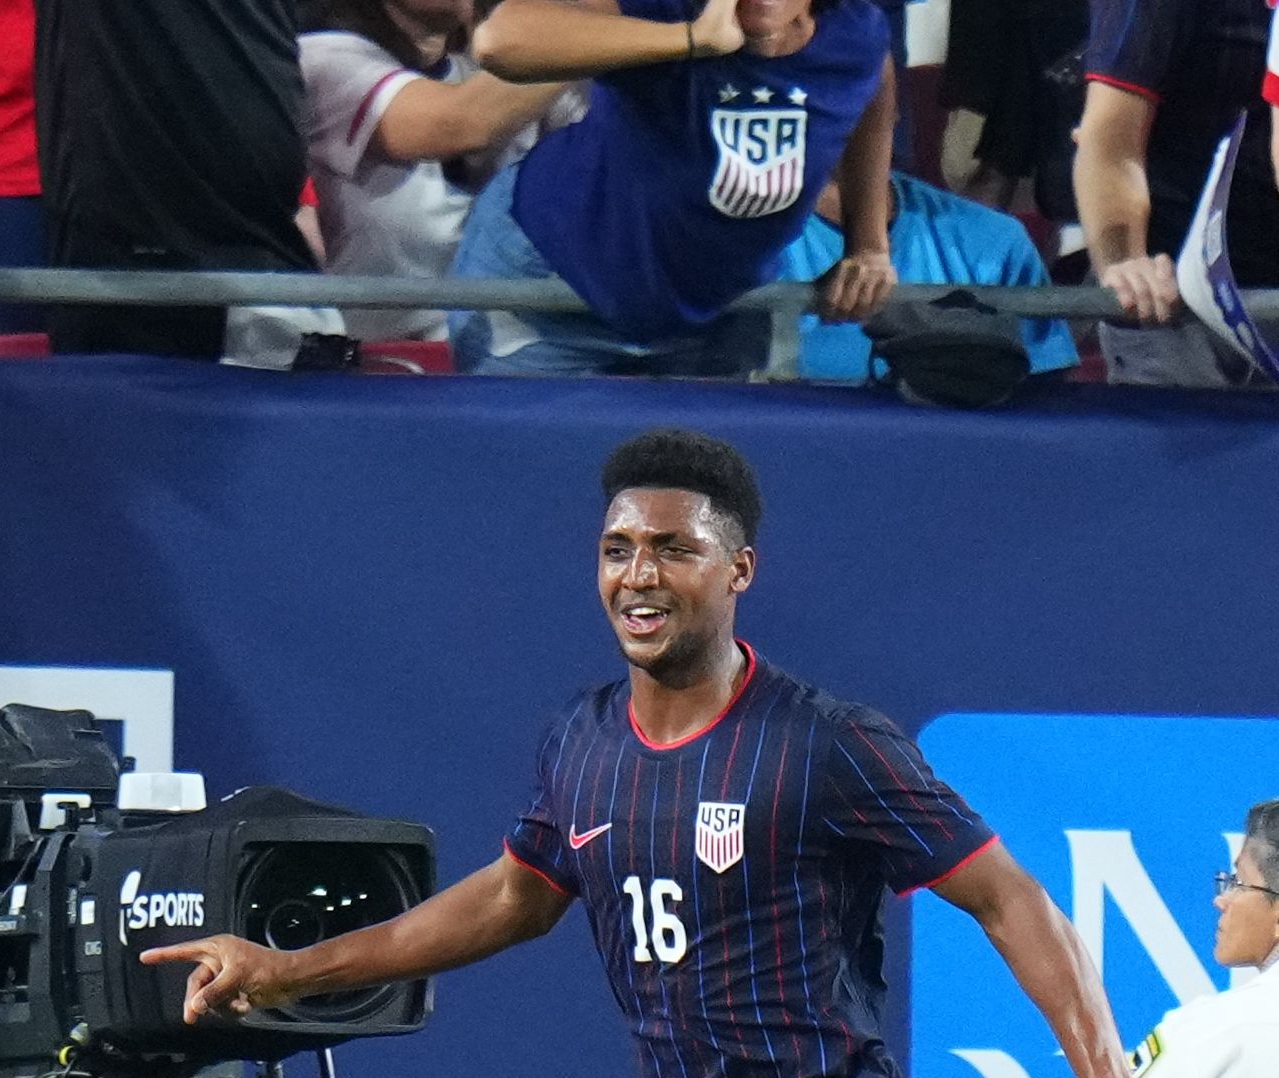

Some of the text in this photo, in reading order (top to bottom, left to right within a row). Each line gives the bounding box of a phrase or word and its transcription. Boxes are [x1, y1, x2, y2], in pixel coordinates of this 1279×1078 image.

[719, 117, 799, 166] USA
[701, 806, 741, 833] USA
[128, 892, 205, 930] SPORTS
[622, 875, 688, 963] 16
